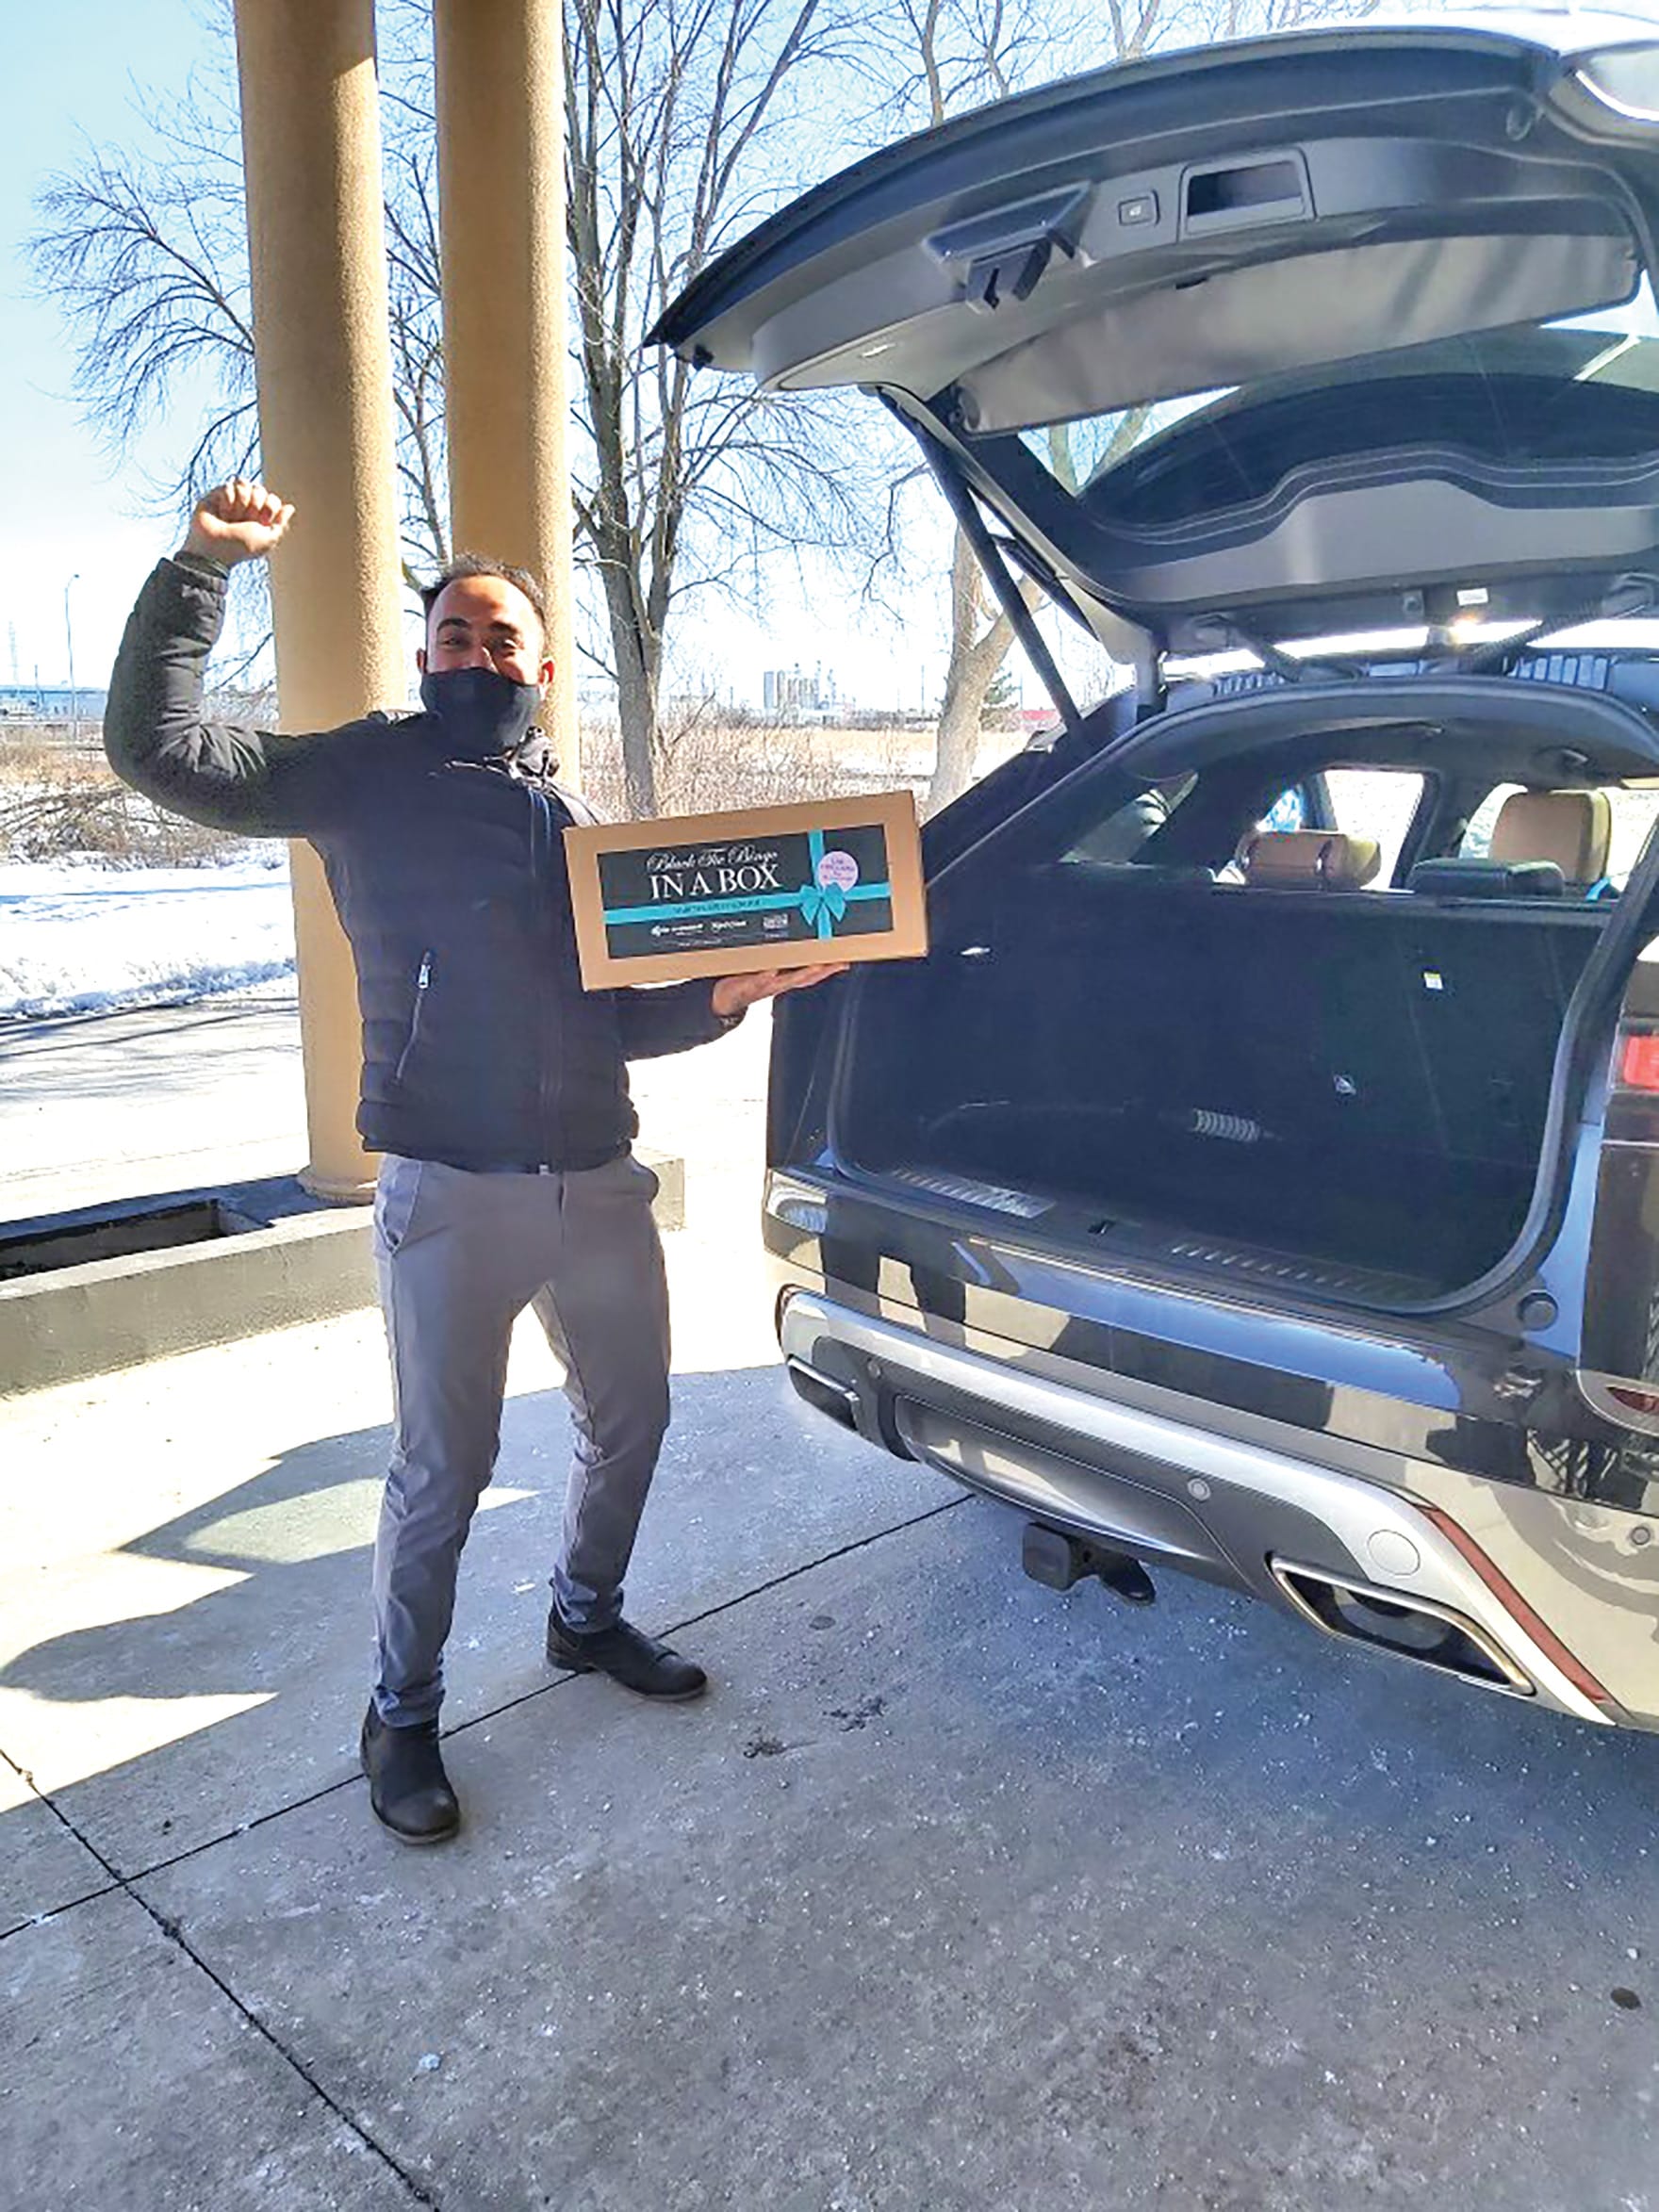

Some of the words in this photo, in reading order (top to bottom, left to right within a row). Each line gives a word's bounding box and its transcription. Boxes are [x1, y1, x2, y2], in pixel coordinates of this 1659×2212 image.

[649, 872, 684, 900] IN
[689, 871, 714, 896] A
[716, 862, 781, 893] BOX
